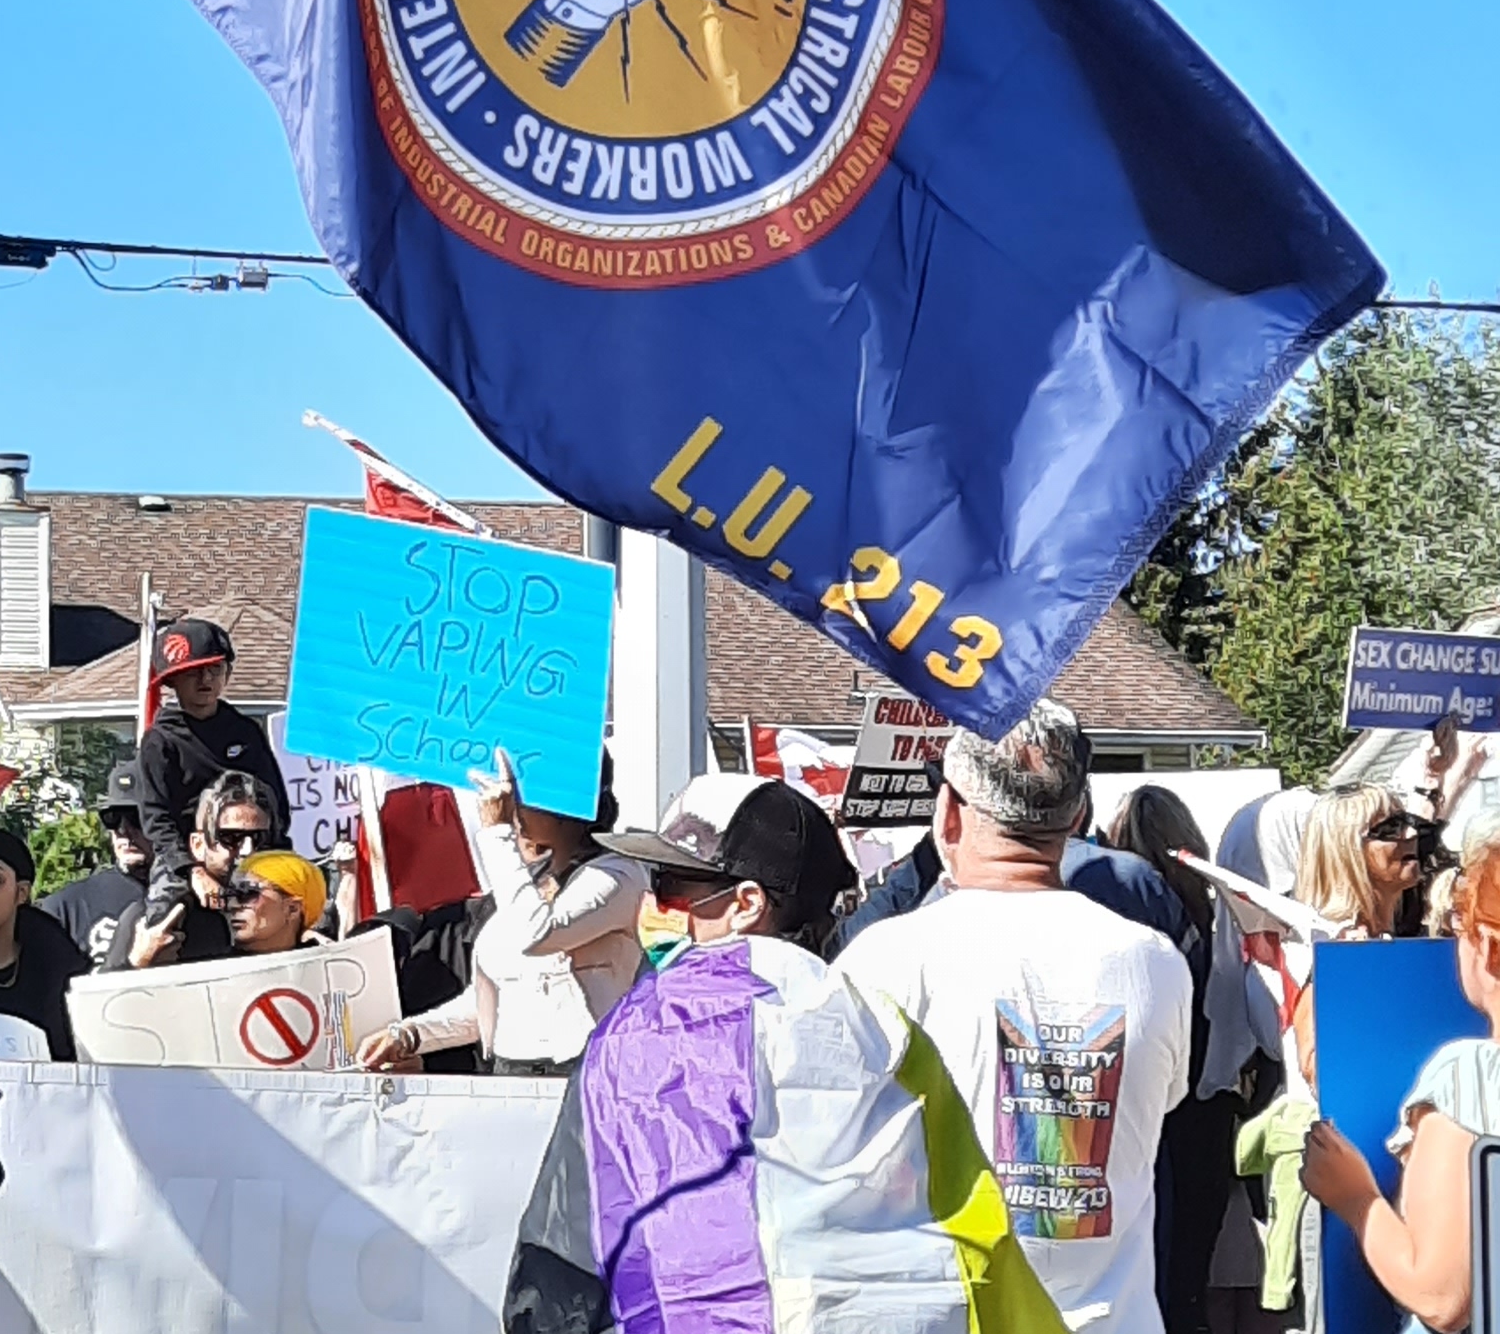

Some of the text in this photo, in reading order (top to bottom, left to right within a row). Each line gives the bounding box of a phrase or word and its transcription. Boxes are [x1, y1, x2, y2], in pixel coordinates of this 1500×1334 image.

[389, 116, 507, 244] INDUSTRIAL
[521, 229, 754, 277] ORGANIZATIONS
[765, 223, 792, 249] &
[792, 113, 892, 233] CANADIAN
[880, 8, 934, 109] LABOUR
[503, 113, 753, 200] WORKERS
[650, 415, 1004, 689] L.U. 213
[405, 540, 560, 645] STOP
[357, 611, 579, 696] VAPING
[1355, 639, 1394, 669] SEX
[1396, 642, 1478, 673] CHANGE
[437, 673, 505, 730] IN
[1351, 680, 1444, 714] Minimum
[289, 778, 322, 811] IS
[1037, 1024, 1084, 1043] OUR
[1004, 1049, 1118, 1069] DIVERSITY
[1021, 1072, 1045, 1090] IS
